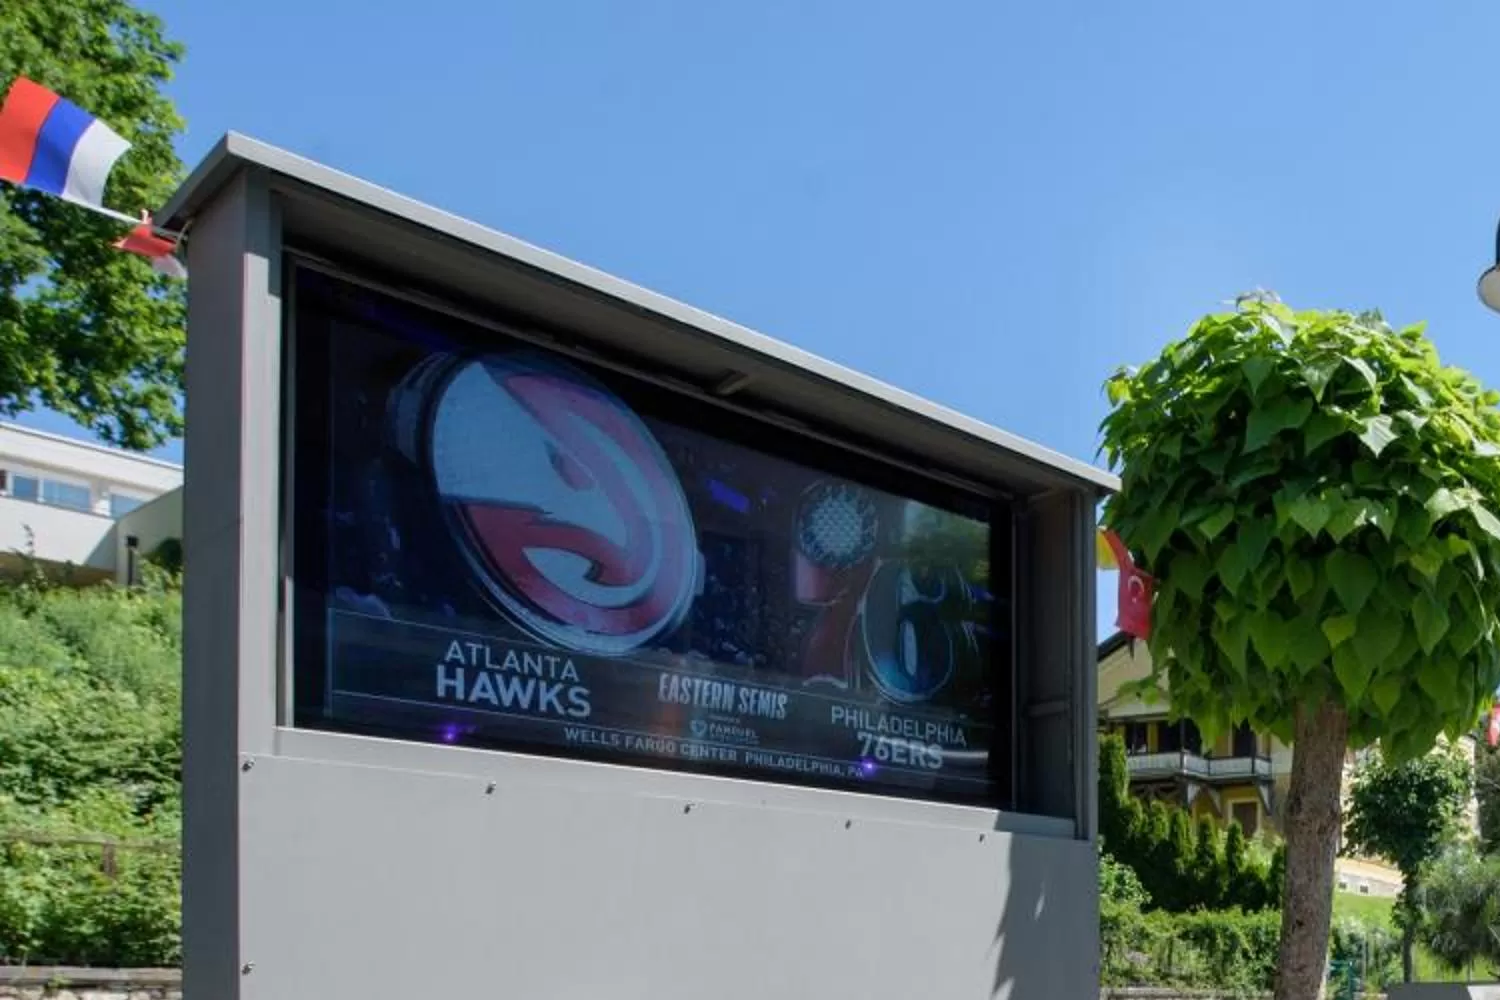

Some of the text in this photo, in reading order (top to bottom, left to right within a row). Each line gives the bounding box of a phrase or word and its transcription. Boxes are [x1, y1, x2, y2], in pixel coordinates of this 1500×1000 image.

[444, 640, 580, 682] ATLANTA
[436, 664, 591, 717] HAWKS
[658, 672, 789, 720] EASTERN SEMIS
[564, 727, 620, 747] WELLS
[679, 743, 737, 761] CENTER
[831, 705, 967, 748] PHILADELPHIA
